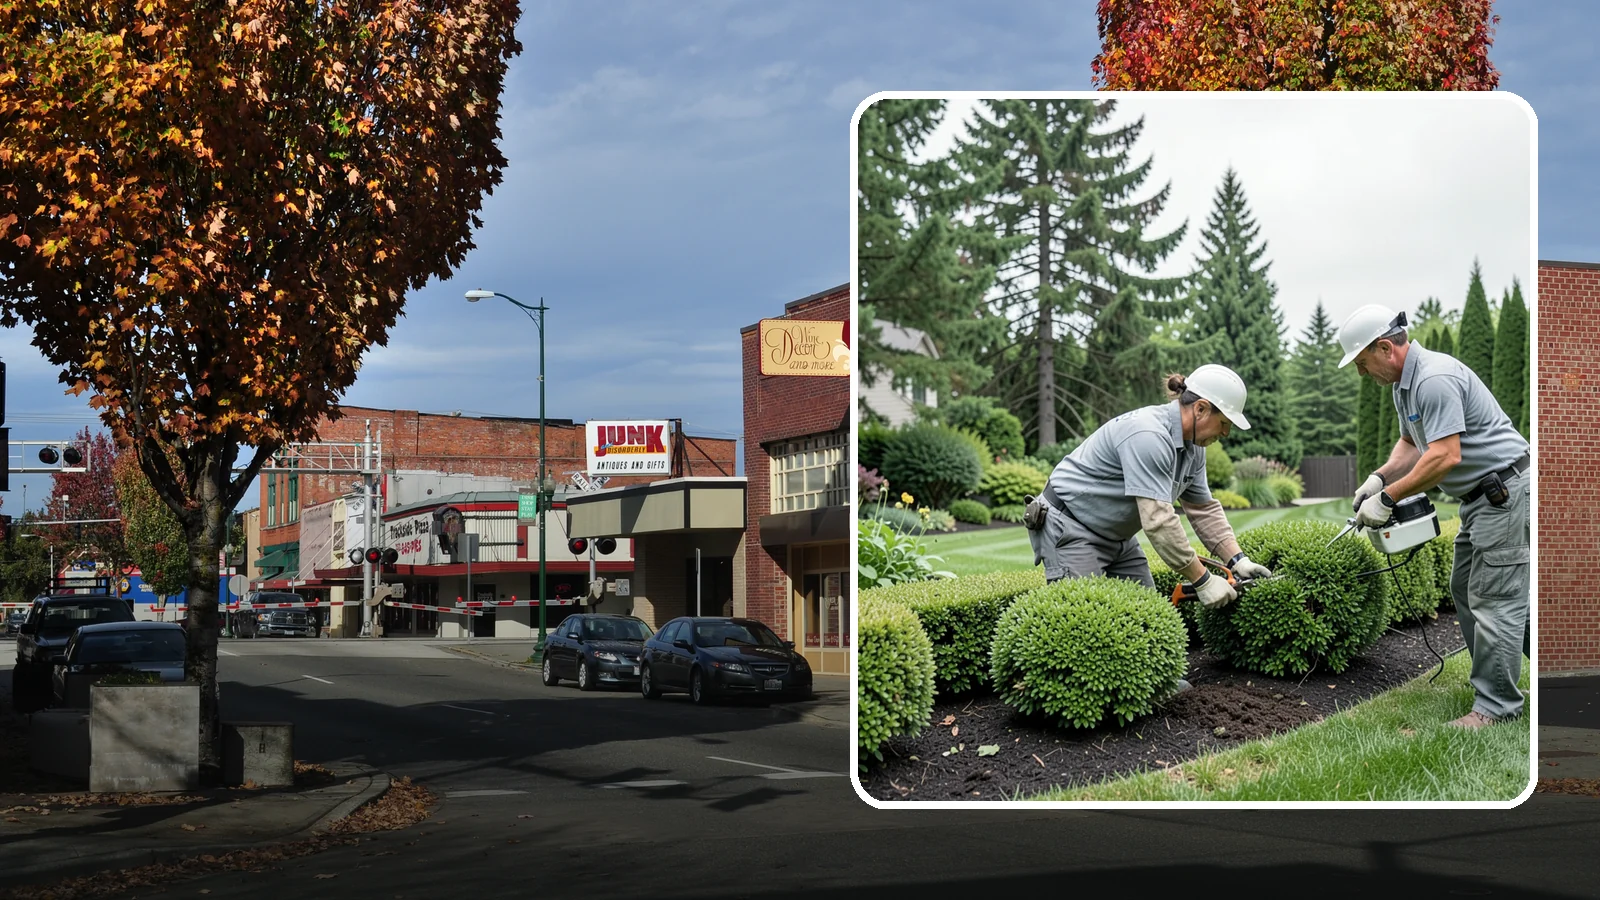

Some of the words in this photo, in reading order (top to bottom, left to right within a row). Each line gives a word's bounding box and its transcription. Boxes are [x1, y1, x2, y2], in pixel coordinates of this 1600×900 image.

[595, 424, 666, 458] JUNK
[607, 446, 646, 454] DISORDERLY
[597, 461, 628, 470] ANTIQUES
[631, 460, 644, 470] AND
[647, 460, 665, 470] GIFTS
[414, 519, 429, 535] Pizza
